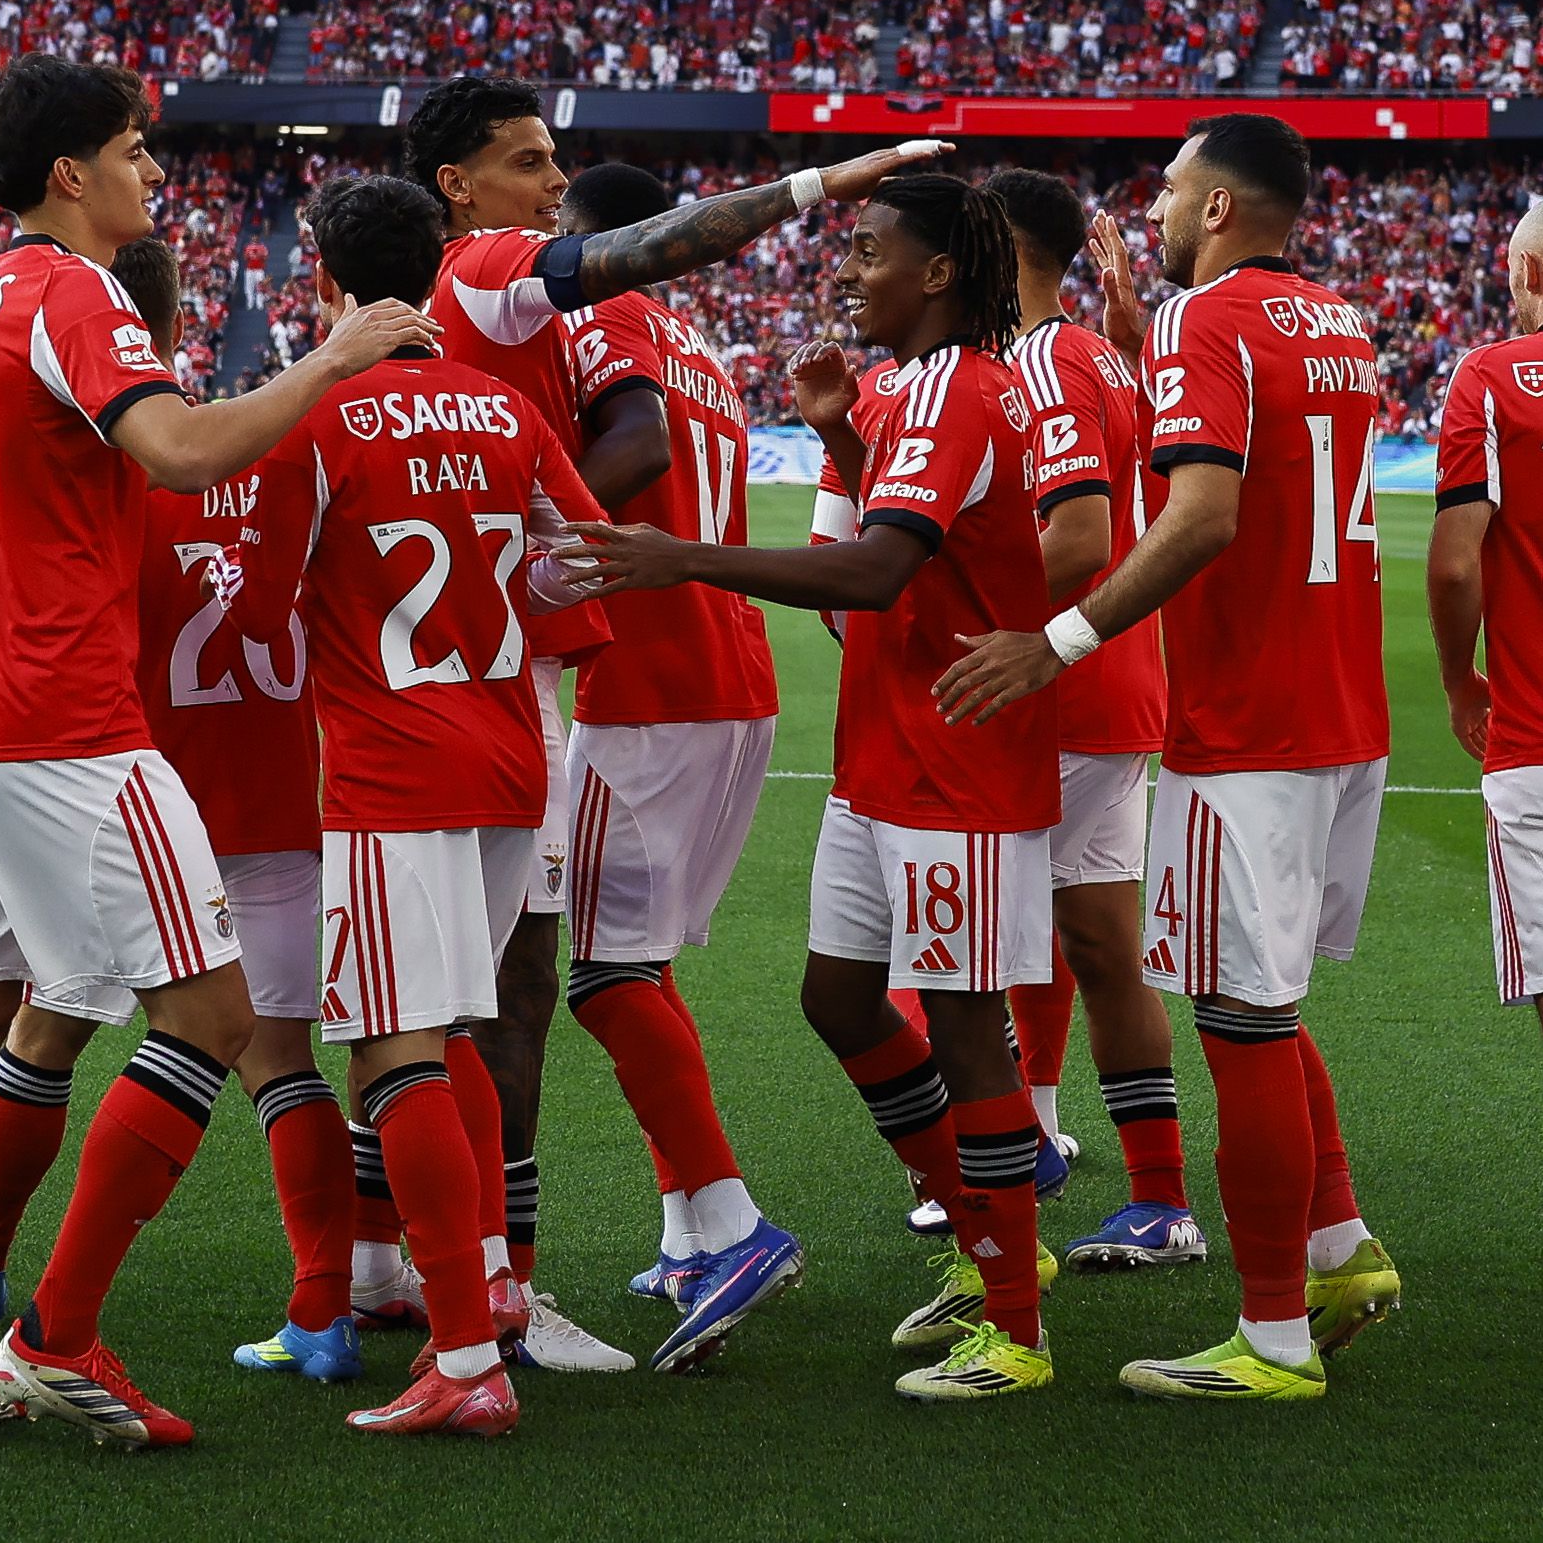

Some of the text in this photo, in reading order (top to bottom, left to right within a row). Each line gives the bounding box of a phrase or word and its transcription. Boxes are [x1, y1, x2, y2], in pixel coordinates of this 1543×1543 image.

[1294, 295, 1373, 345] SAGRE
[382, 392, 520, 440] SAGRES
[407, 454, 490, 496] RAFA
[868, 481, 938, 503] Betano
[1038, 455, 1100, 484] Betano
[1305, 414, 1380, 584] 14
[366, 512, 525, 691] 27
[901, 860, 966, 936] 18
